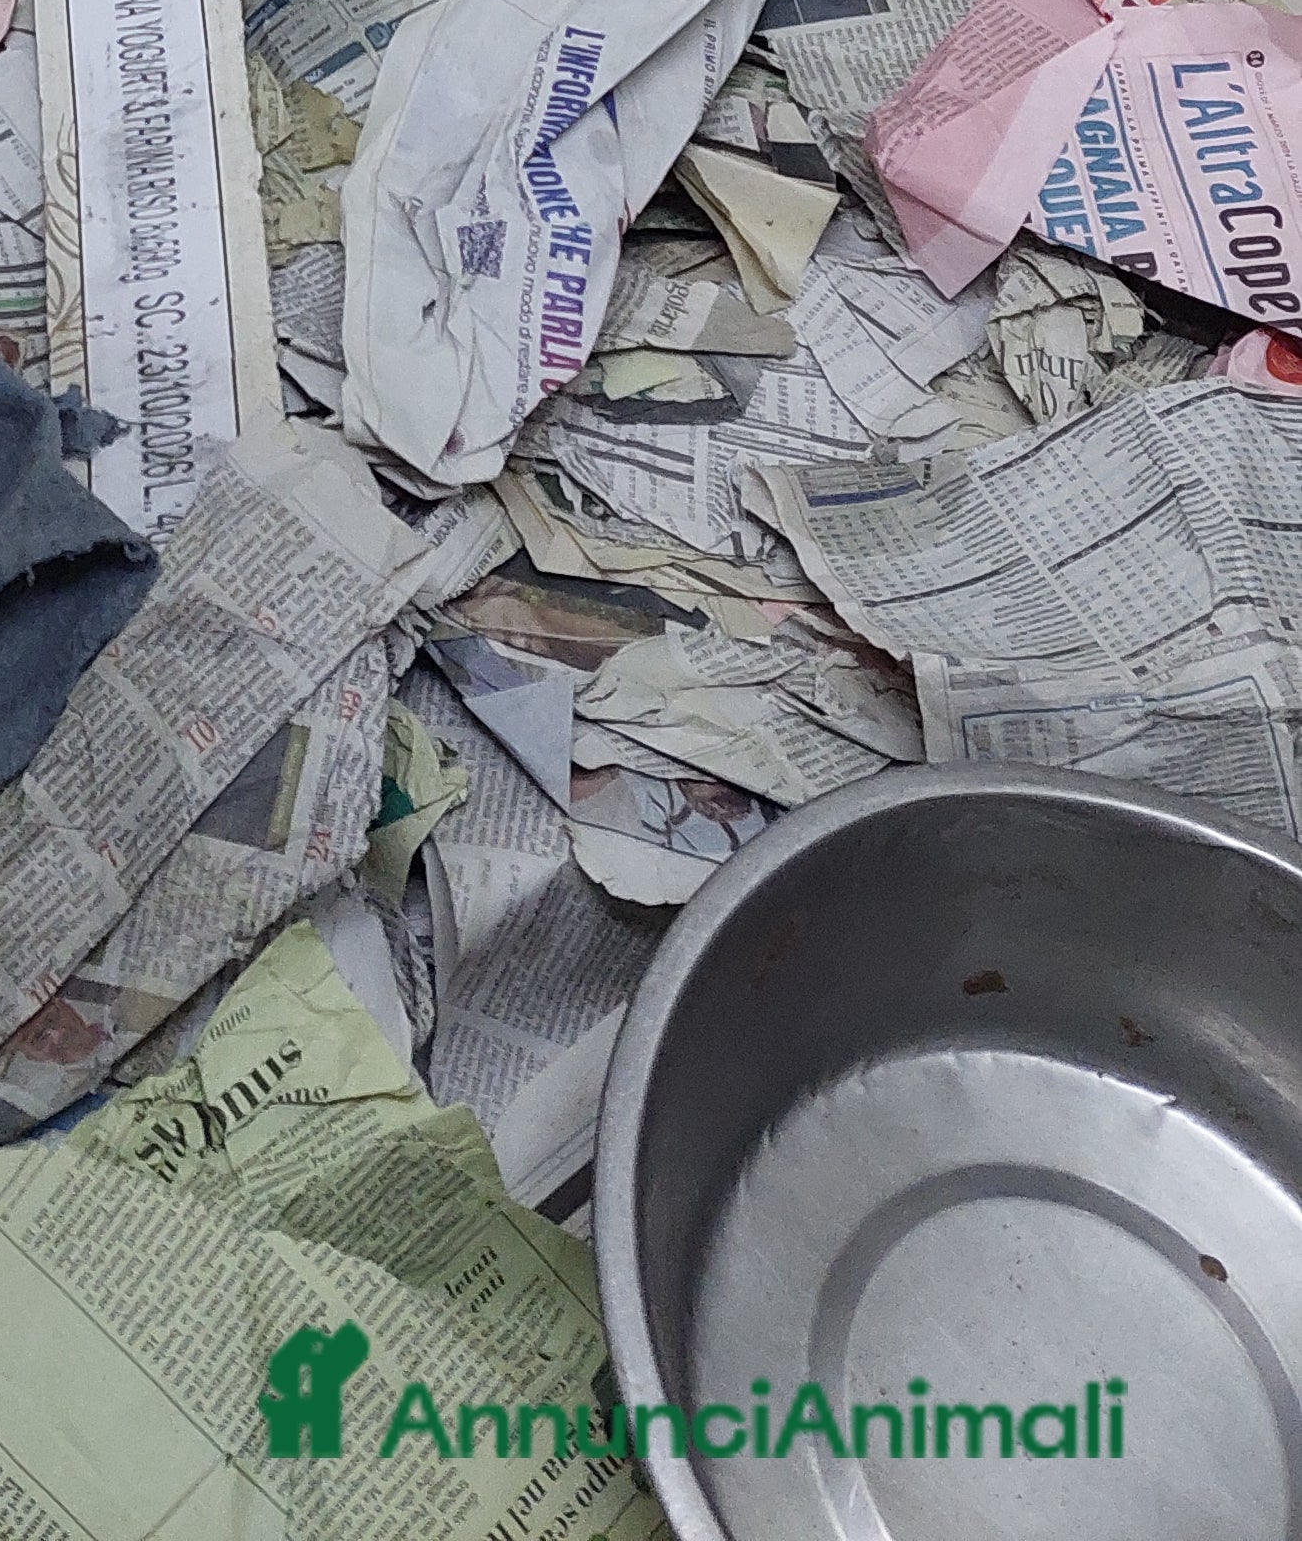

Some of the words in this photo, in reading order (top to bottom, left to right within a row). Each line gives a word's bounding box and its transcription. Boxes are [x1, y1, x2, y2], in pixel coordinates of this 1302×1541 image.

[116, 19, 166, 96] YOGURT
[524, 222, 542, 274] nuovo
[521, 276, 536, 324] modo
[539, 269, 586, 372] PARLA
